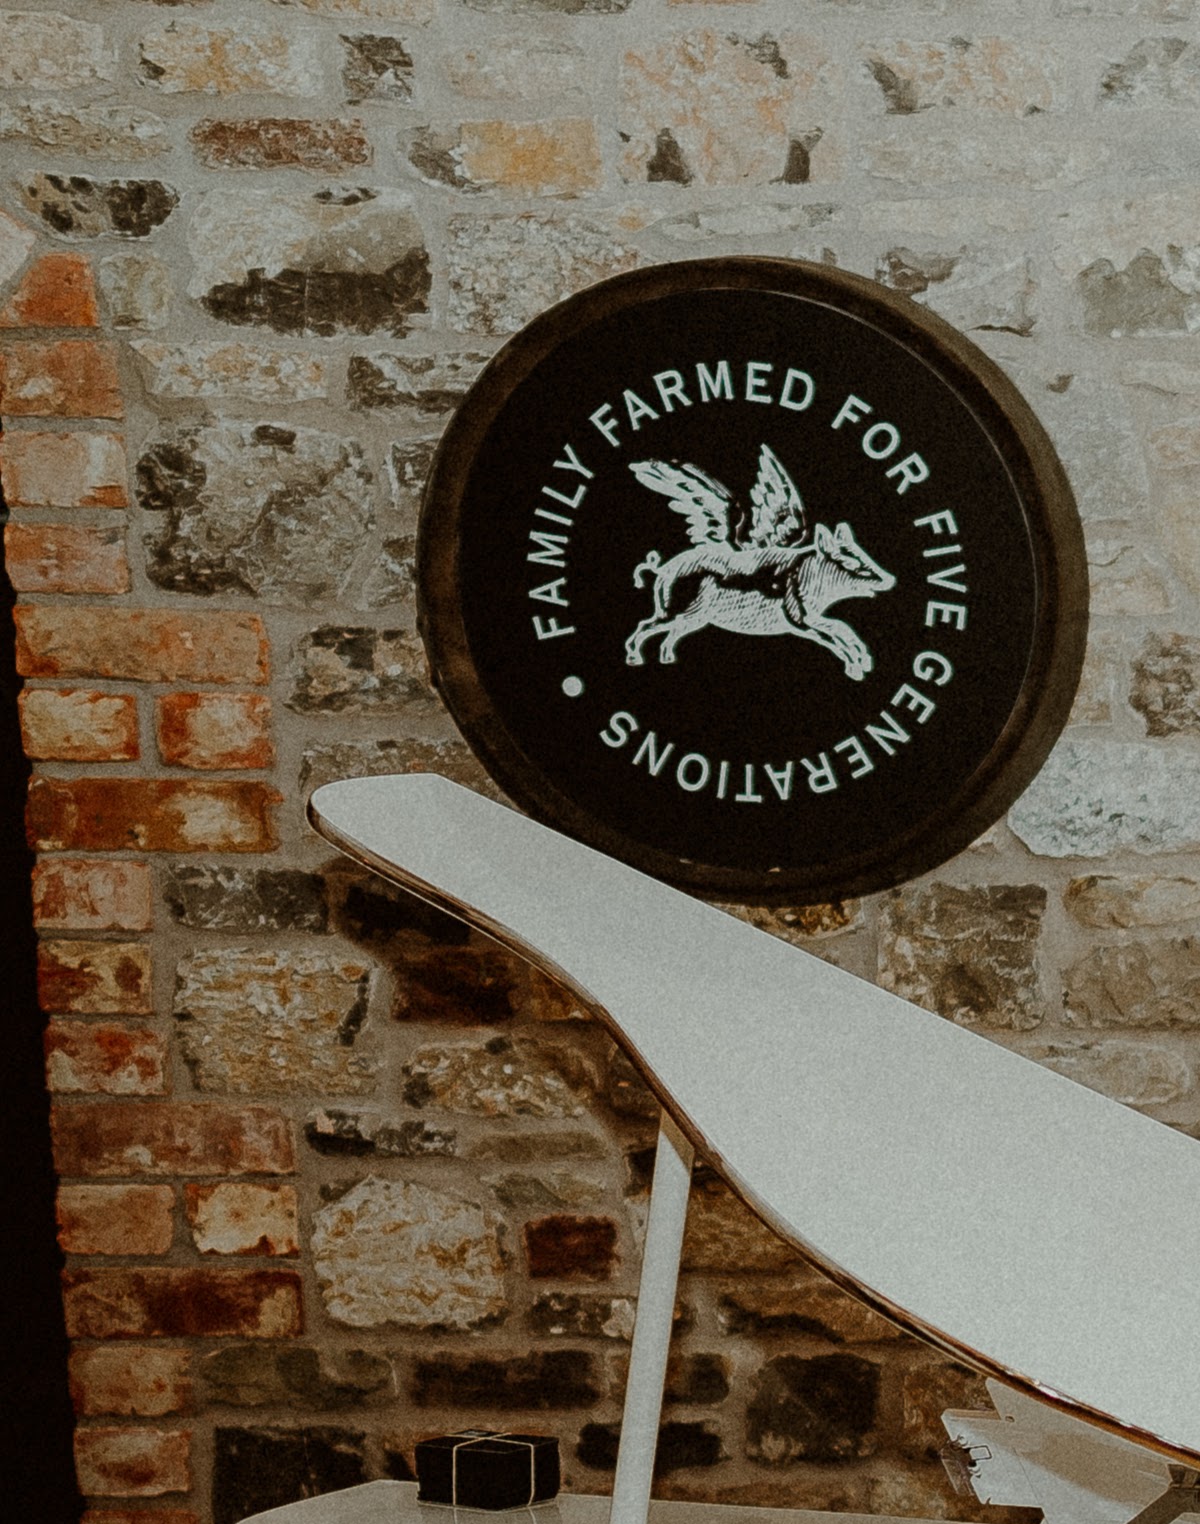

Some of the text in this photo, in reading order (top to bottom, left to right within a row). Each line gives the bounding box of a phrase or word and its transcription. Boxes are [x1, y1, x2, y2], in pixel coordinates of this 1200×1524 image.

[527, 360, 968, 803] FAMILY FARMED FOR FIVE GENERATIONS
